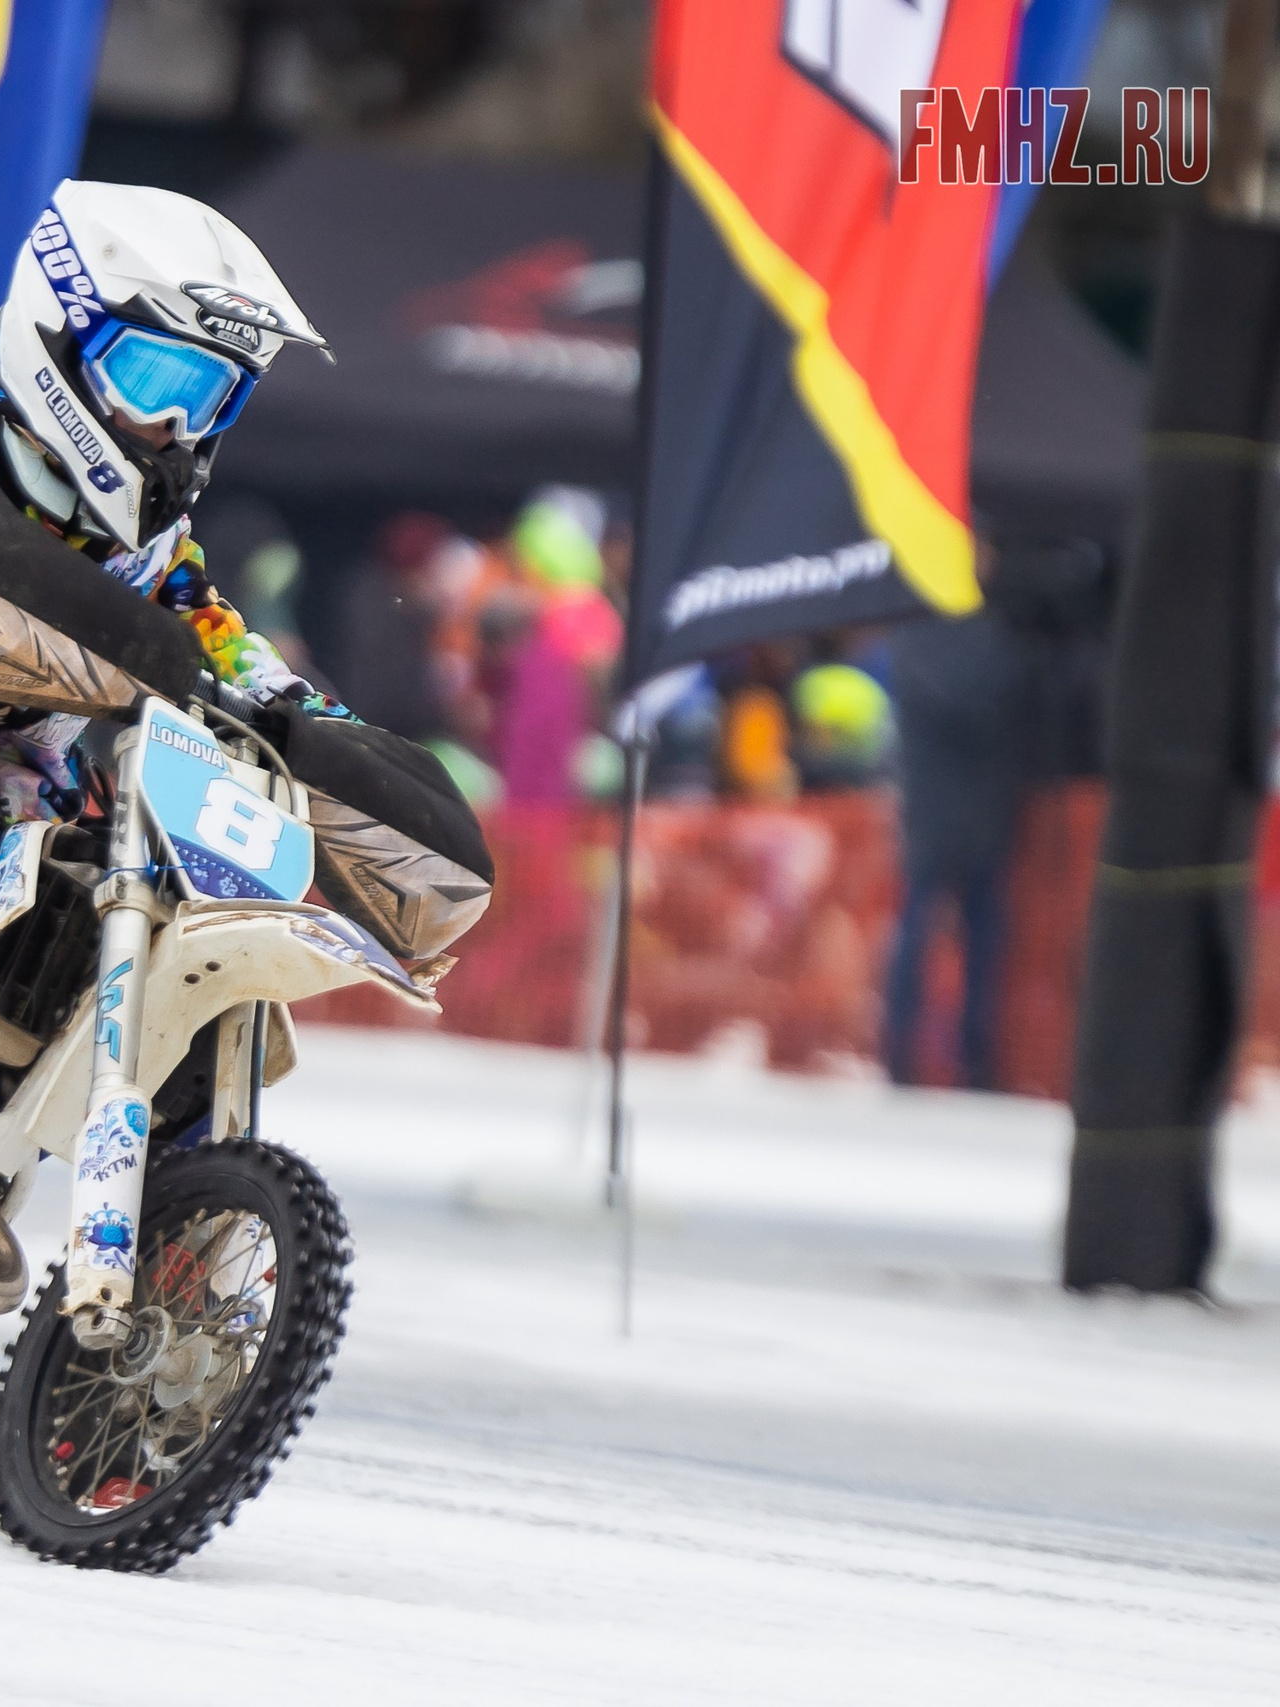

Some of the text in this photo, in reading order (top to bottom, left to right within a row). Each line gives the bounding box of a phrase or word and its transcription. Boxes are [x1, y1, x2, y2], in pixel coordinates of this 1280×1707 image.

[187, 287, 278, 327] Airoh
[46, 387, 127, 494] LOMOVA 8
[150, 721, 226, 770] LOMOVA
[195, 777, 286, 871] 8
[93, 1153, 139, 1183] KTM
